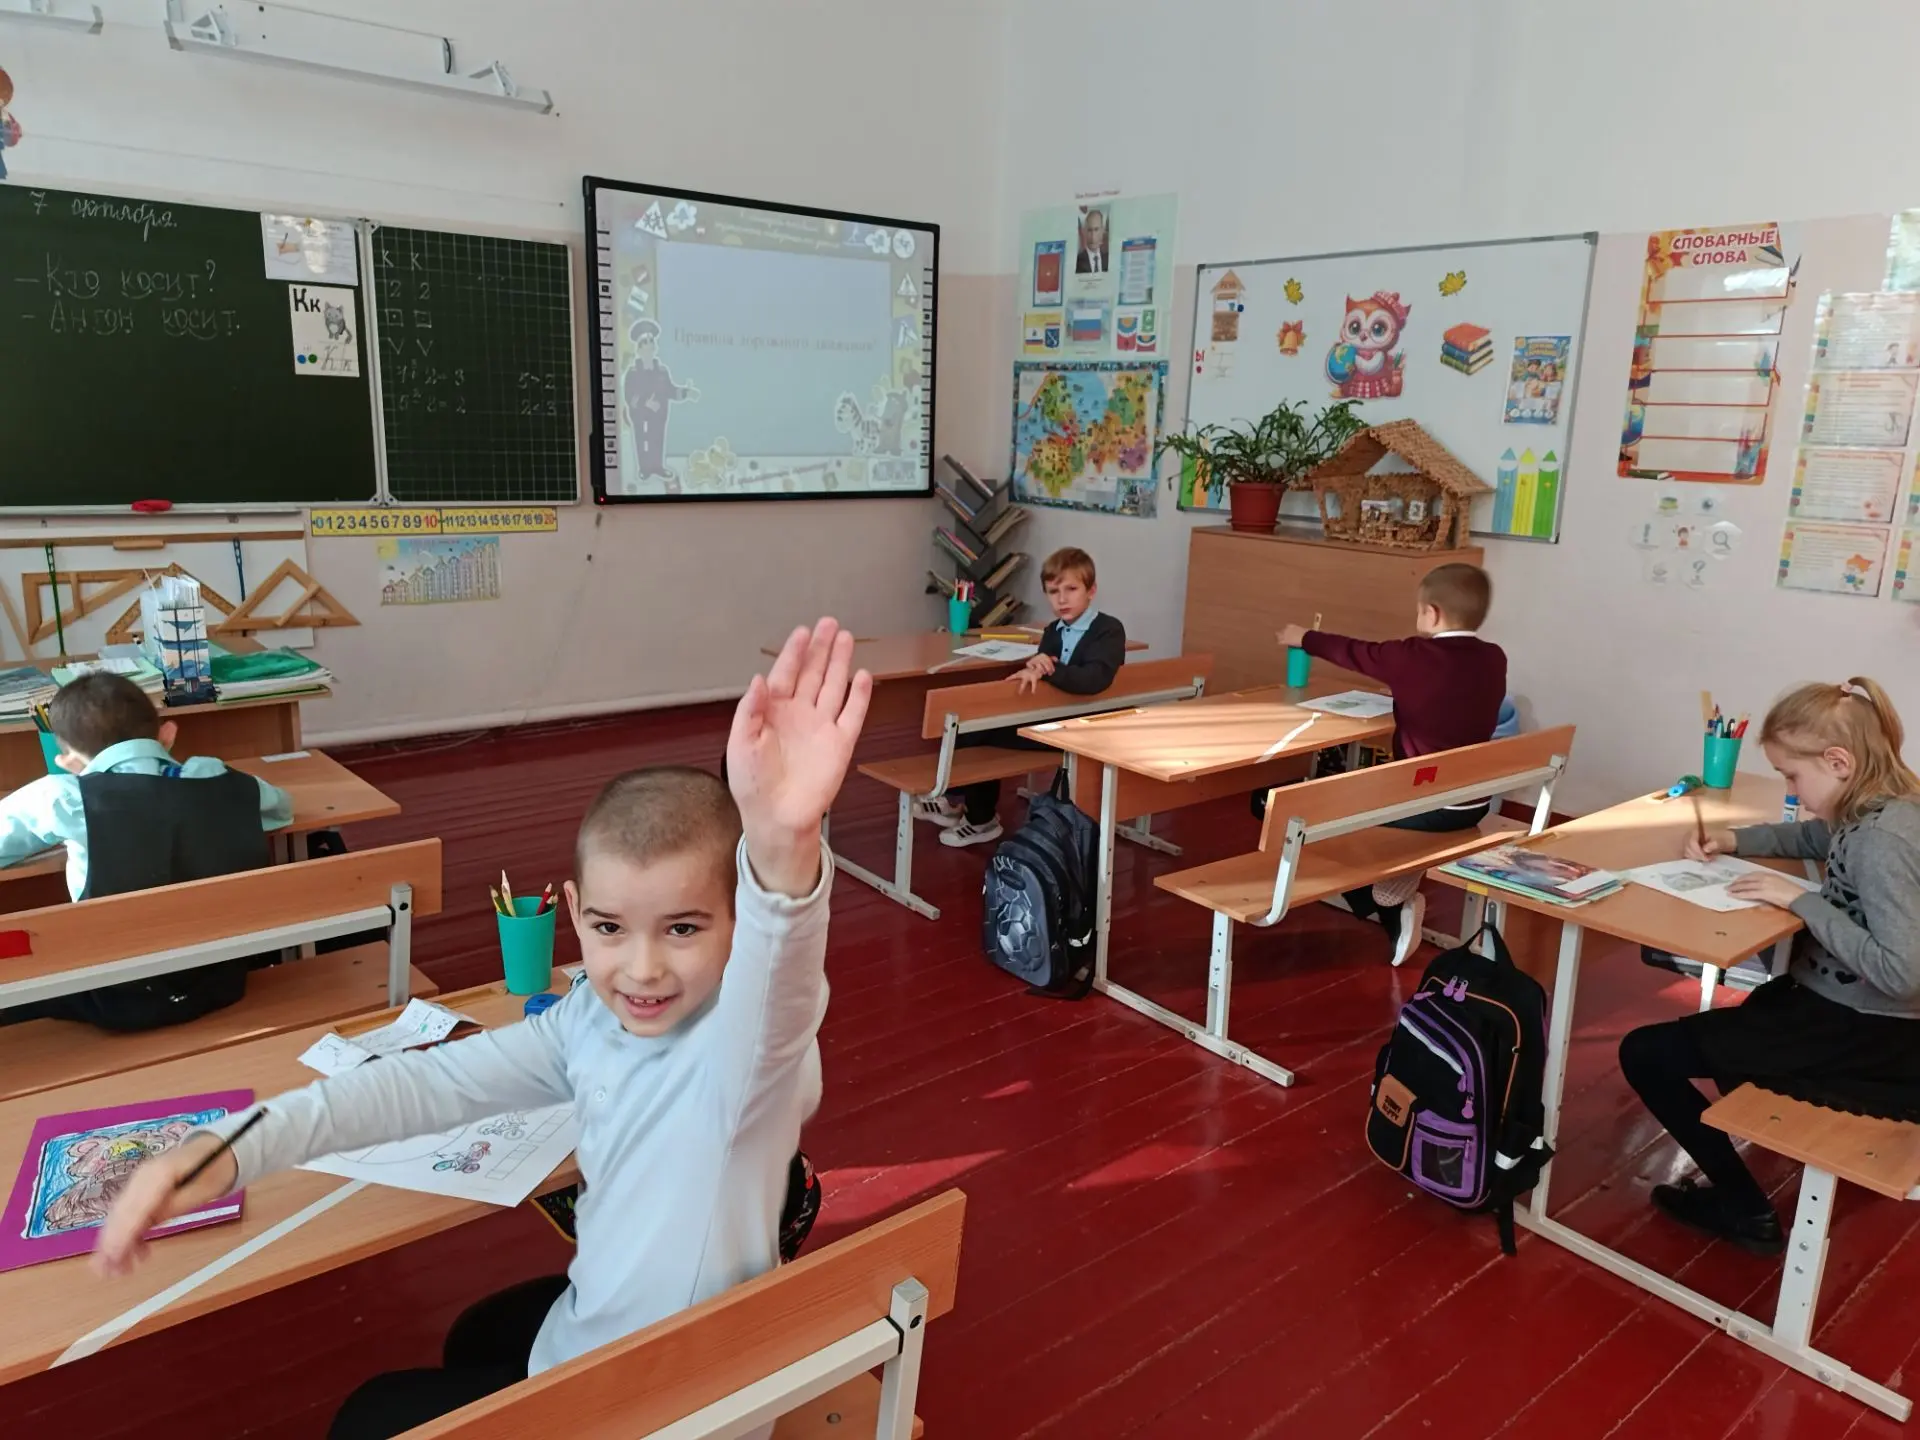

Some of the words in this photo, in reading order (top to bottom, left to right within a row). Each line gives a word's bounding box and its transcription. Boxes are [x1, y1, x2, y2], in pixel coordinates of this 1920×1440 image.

[29, 191, 48, 216] 7
[1672, 230, 1776, 250] СЛОВАРНЫЕ
[1692, 250, 1748, 265] СЛОВА
